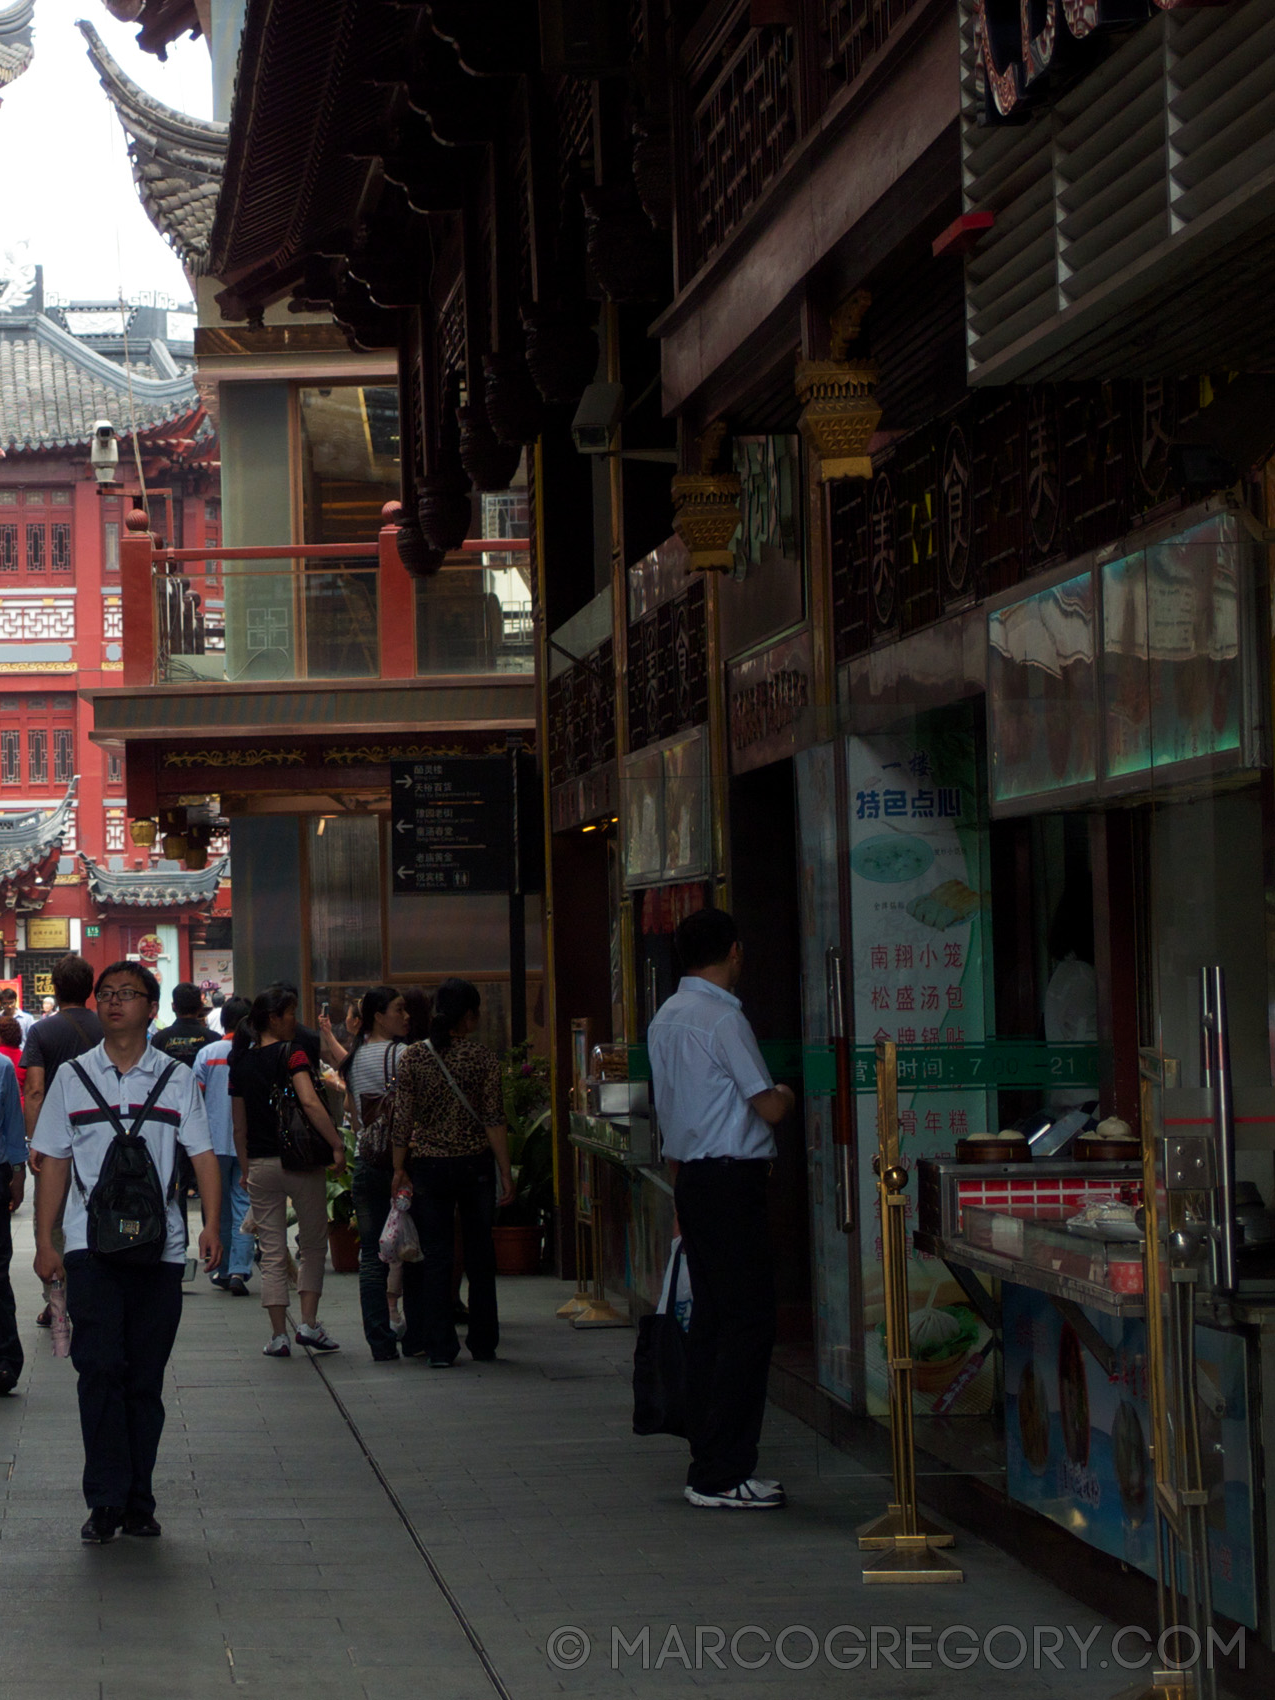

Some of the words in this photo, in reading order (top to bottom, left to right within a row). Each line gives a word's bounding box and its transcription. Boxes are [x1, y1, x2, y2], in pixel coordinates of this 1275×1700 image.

[881, 750, 934, 777] 一楼
[856, 788, 962, 819] 特色点心
[870, 942, 963, 970] 南翔小笼
[871, 984, 964, 1011] 松盛汤包
[875, 1110, 969, 1136] 骨年糕
